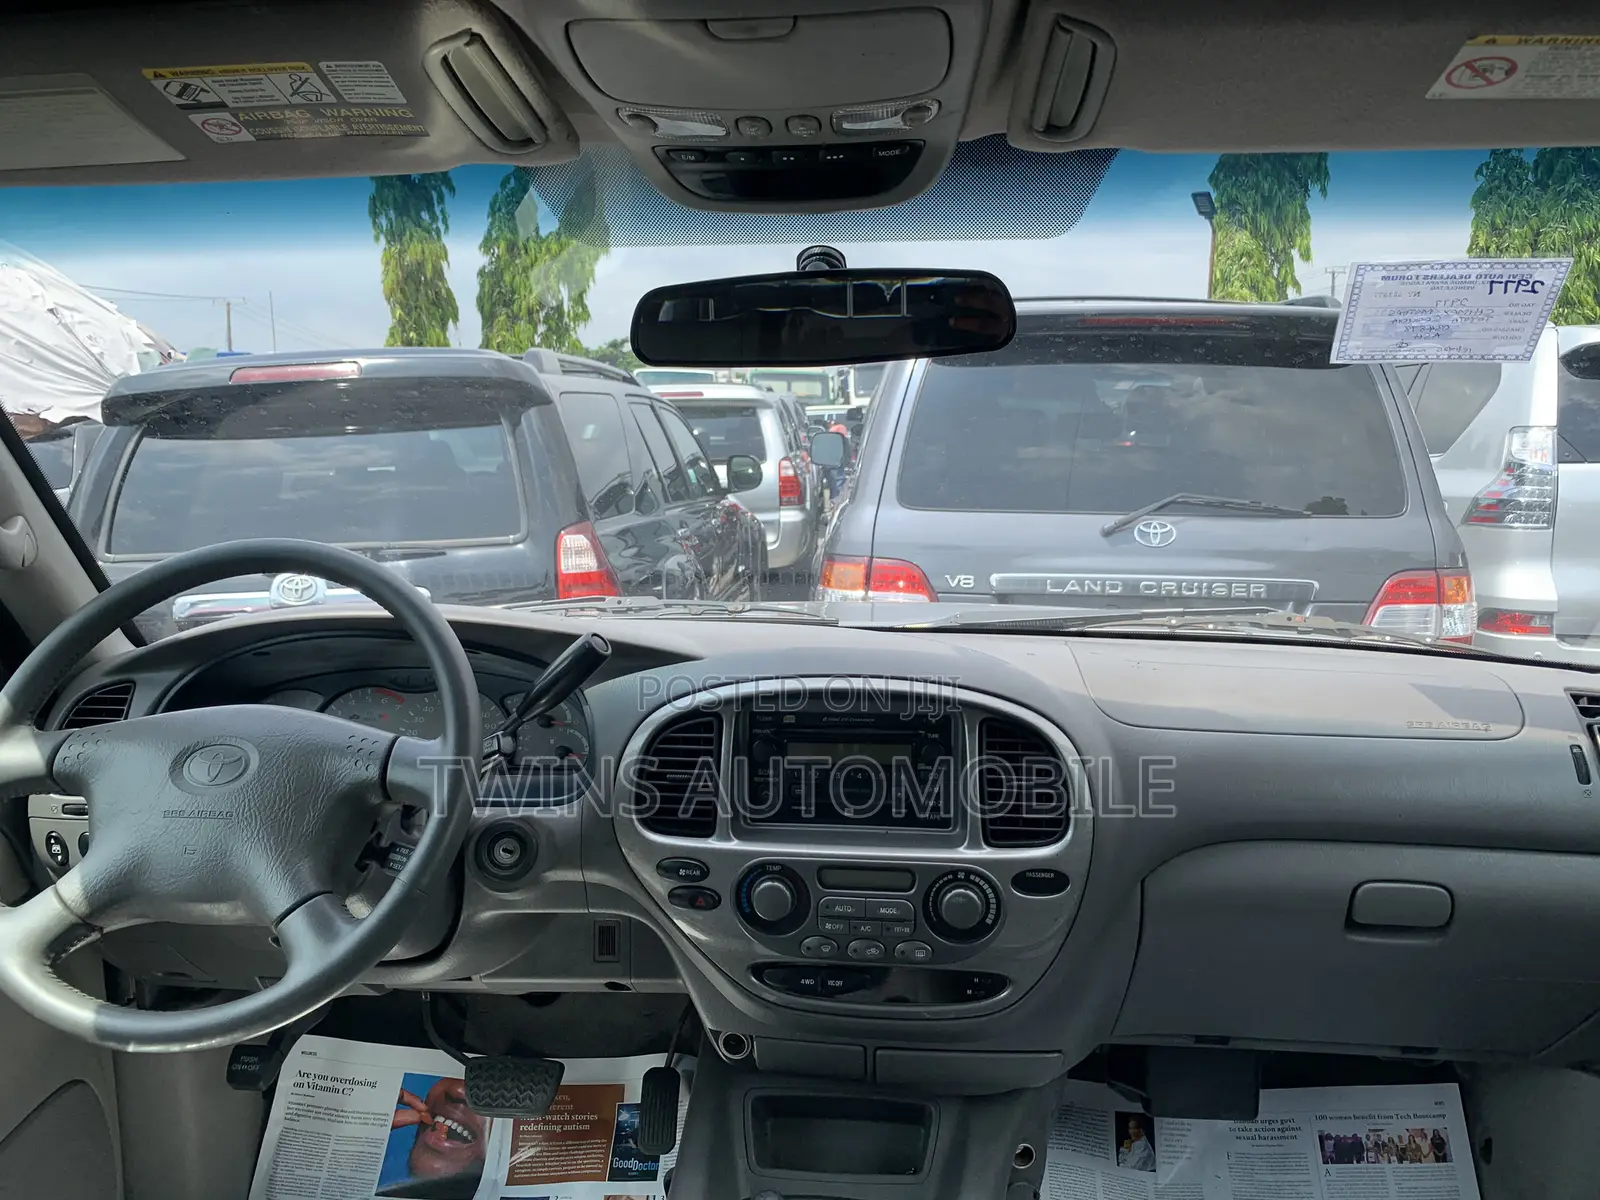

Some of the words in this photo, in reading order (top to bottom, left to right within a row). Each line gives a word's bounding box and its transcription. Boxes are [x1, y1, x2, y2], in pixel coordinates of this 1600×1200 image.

[237, 109, 311, 121] AIRBAG
[320, 107, 414, 119] WARNING
[944, 575, 975, 588] V8
[1045, 579, 1122, 594] LAND
[1139, 581, 1268, 598] CRUISER
[1025, 871, 1055, 879] PASSENGER
[296, 1069, 312, 1079] Are
[313, 1072, 329, 1081] you
[330, 1074, 378, 1089] overdosing
[293, 1081, 305, 1089] on
[306, 1081, 340, 1094] Vitamin
[341, 1087, 354, 1096] C?
[571, 1112, 598, 1121] stories
[520, 1122, 562, 1133] redefining
[563, 1122, 590, 1131] autism
[1277, 1125, 1302, 1133] against
